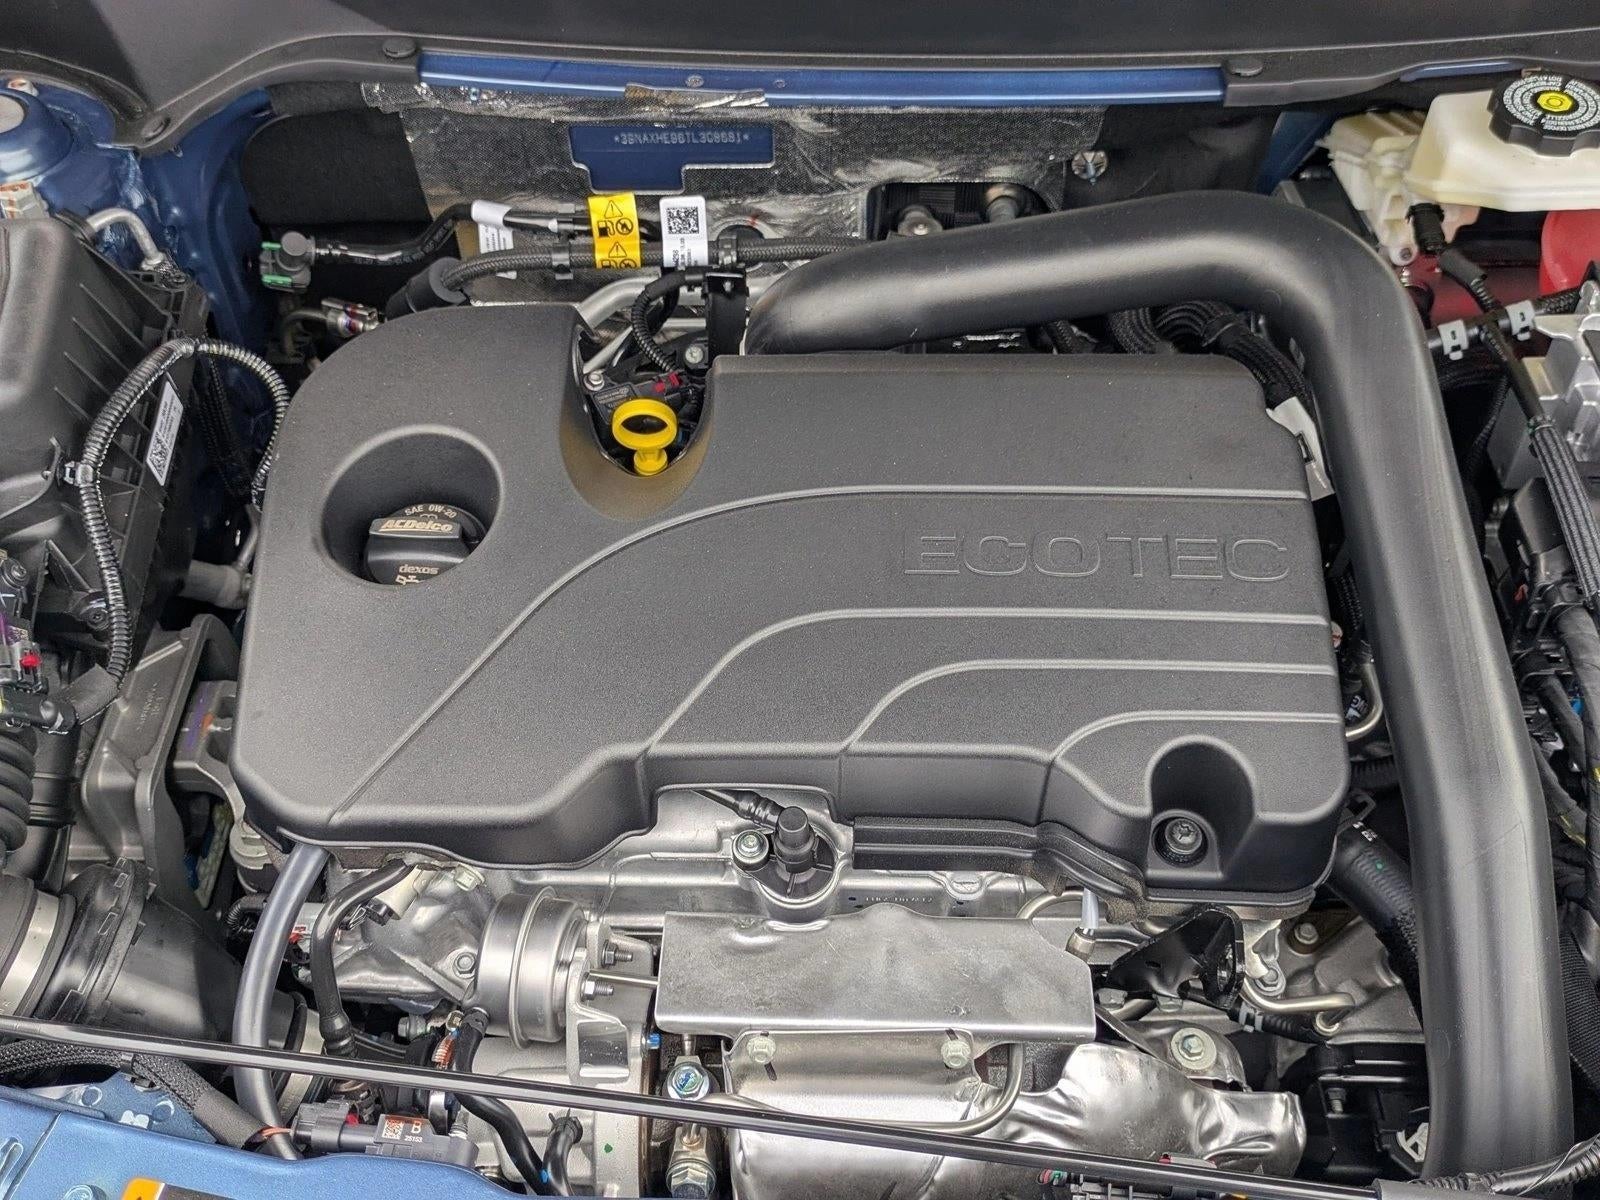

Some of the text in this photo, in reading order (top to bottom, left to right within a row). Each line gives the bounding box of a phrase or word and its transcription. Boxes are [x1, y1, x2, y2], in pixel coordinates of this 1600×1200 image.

[404, 504, 457, 519] SAE 0W-20
[380, 519, 453, 533] ACDelco
[902, 532, 1290, 582] ECOTEC
[399, 564, 440, 575] dexos
